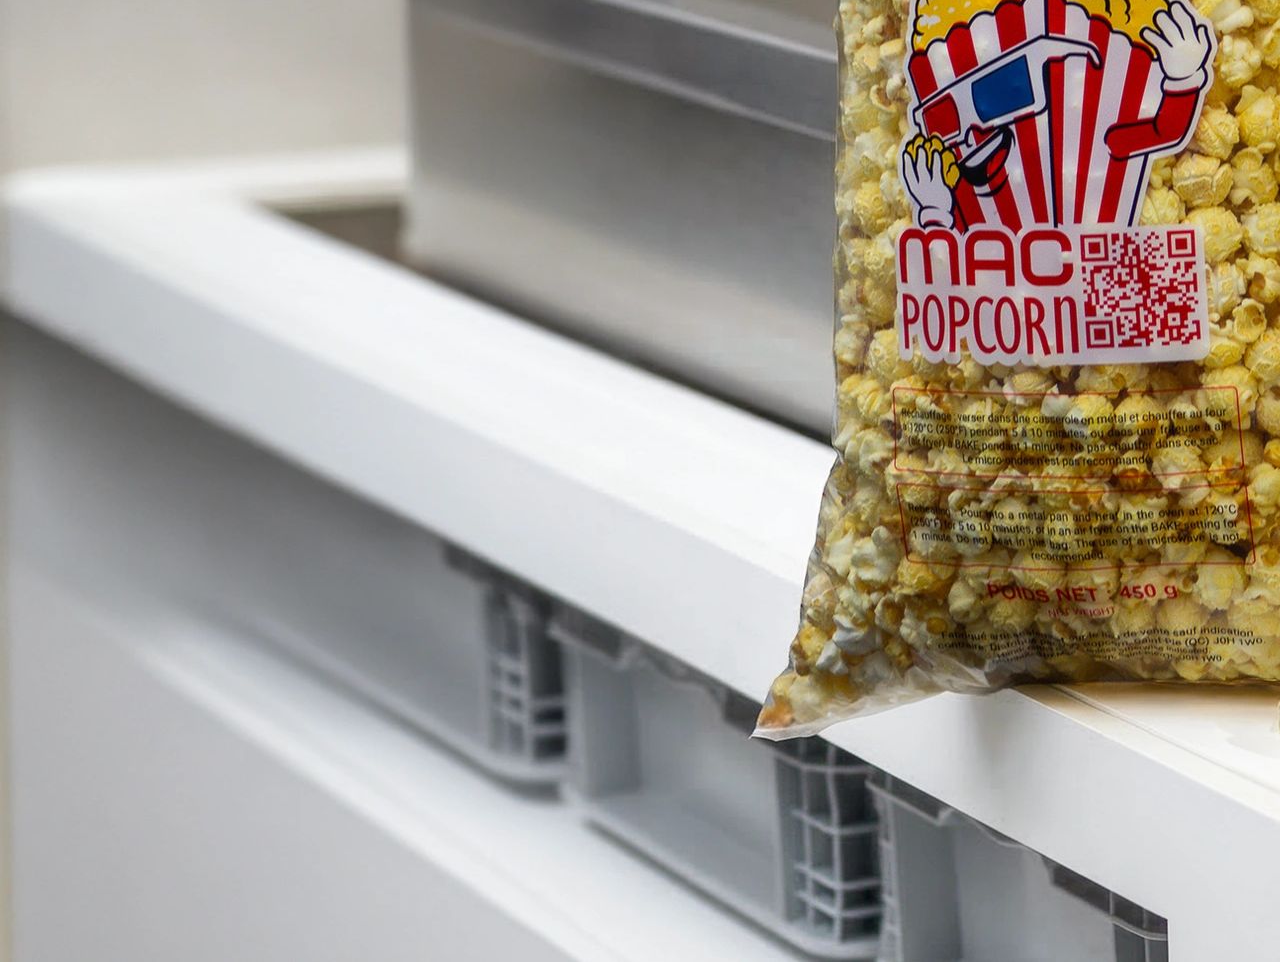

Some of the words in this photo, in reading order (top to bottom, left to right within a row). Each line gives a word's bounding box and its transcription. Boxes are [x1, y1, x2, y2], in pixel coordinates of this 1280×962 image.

[1096, 412, 1127, 425] métal
[1129, 412, 1139, 423] et
[1142, 408, 1187, 420] chauffer
[1189, 409, 1203, 419] au
[1205, 406, 1227, 418] four
[1031, 427, 1043, 438] 10
[1090, 428, 1104, 438] ou
[1087, 443, 1106, 454] pas
[1155, 437, 1181, 450] dans
[1184, 438, 1198, 448] ce
[962, 452, 973, 463] Le
[960, 508, 982, 519] Pour
[1049, 512, 1070, 523] pan
[1123, 511, 1133, 521] in
[1136, 509, 1155, 520] the
[1205, 503, 1237, 516] 120°C
[966, 520, 976, 531] to
[1058, 526, 1071, 537] an
[1115, 523, 1129, 535] on
[1223, 516, 1238, 528] for
[972, 535, 989, 546] not
[1222, 532, 1240, 542] not
[986, 584, 1051, 604] POIDS
[1055, 586, 1099, 603] NET
[1119, 582, 1157, 600] 450
[1163, 585, 1179, 600] g
